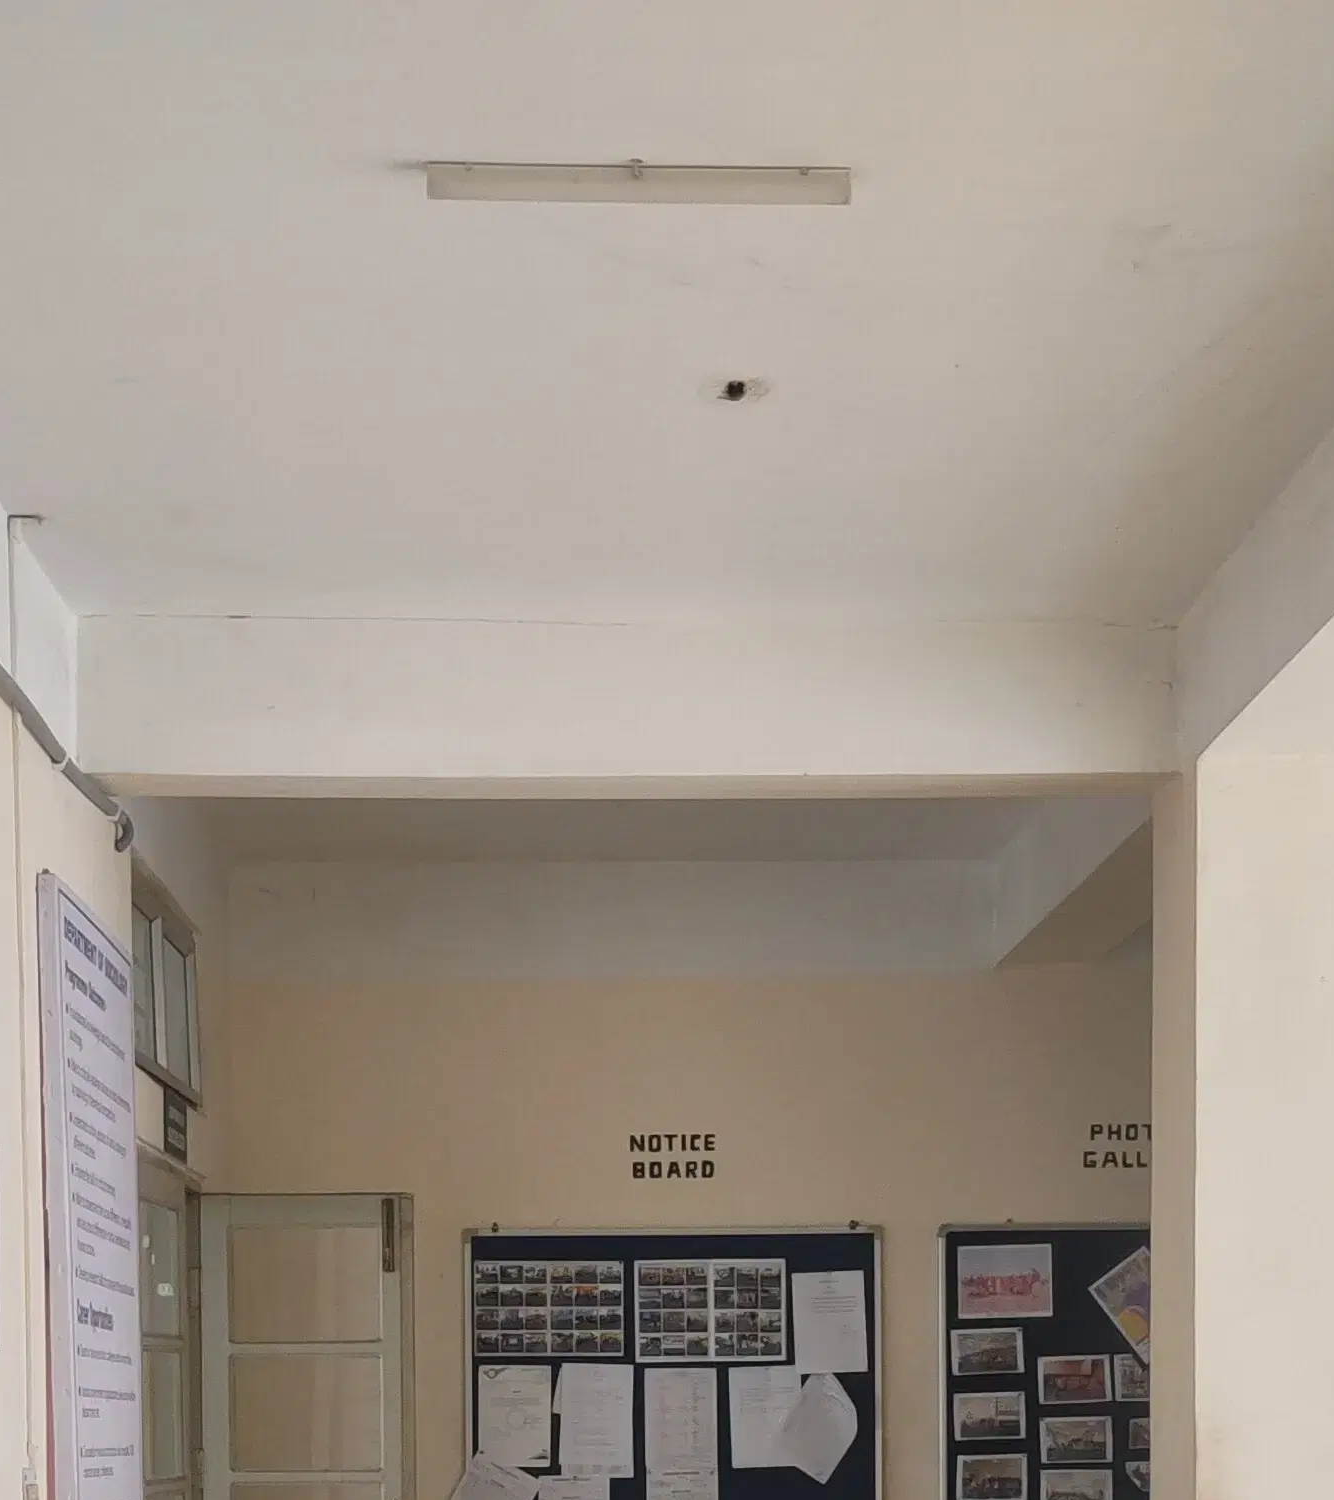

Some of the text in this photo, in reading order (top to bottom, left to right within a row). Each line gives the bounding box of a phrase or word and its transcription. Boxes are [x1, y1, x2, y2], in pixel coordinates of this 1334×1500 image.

[629, 1133, 716, 1152] NOTICE
[1083, 1150, 1148, 1169] GALL
[632, 1160, 715, 1179] BOARD
